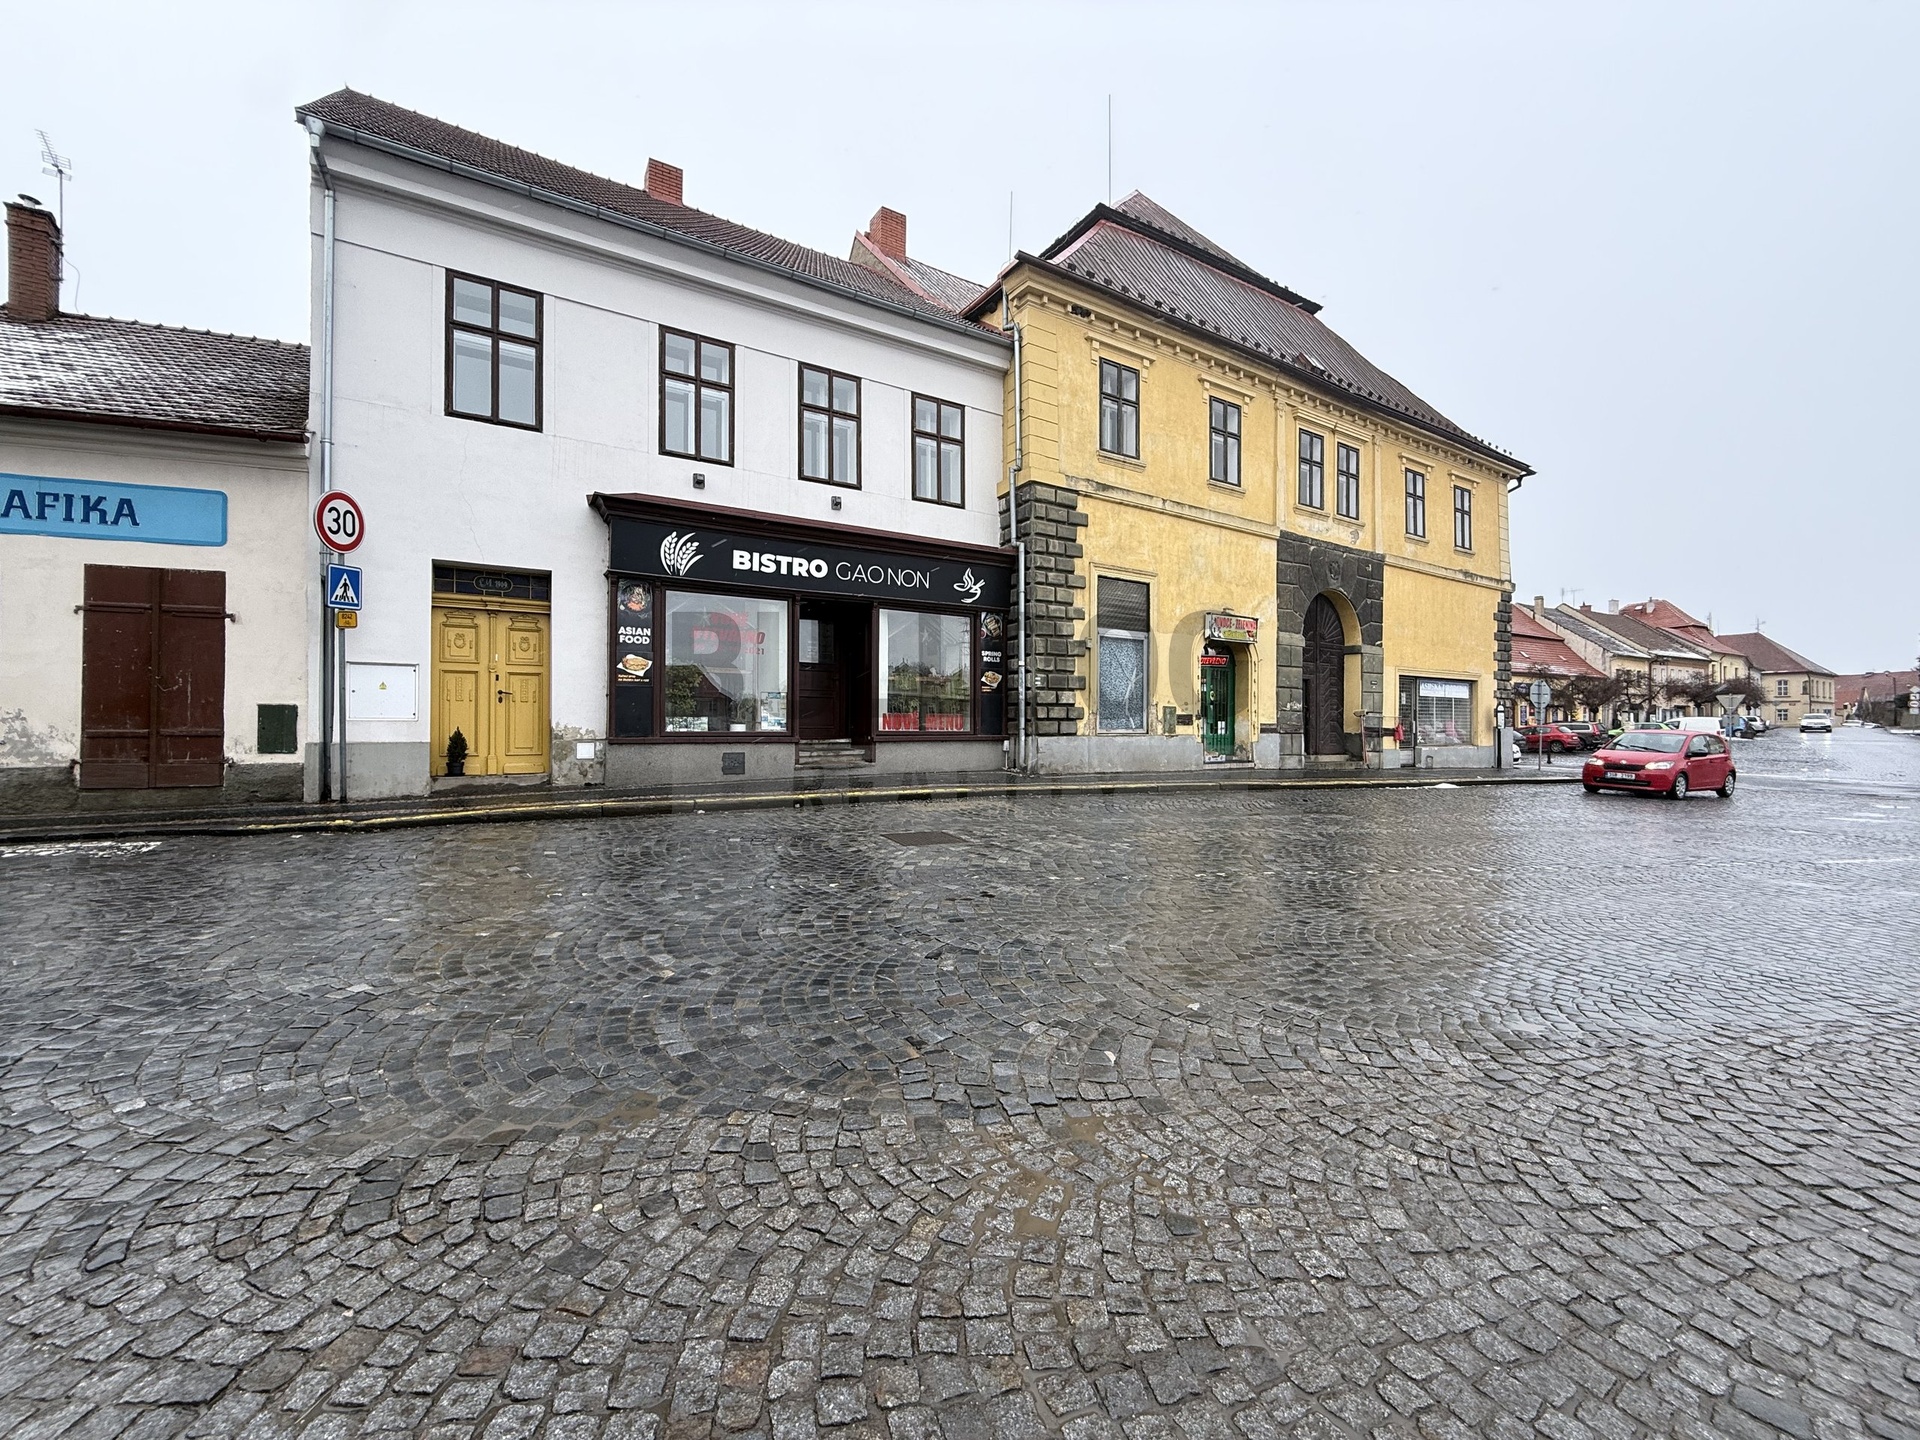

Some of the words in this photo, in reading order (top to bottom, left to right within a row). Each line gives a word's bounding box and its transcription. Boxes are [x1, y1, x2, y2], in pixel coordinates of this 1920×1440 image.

[1, 489, 140, 527] AFIKA
[327, 506, 356, 538] 30
[732, 549, 829, 579] BISTRO
[618, 626, 651, 636] ASIAN
[619, 635, 651, 645] FOOD
[925, 713, 965, 731] MENU
